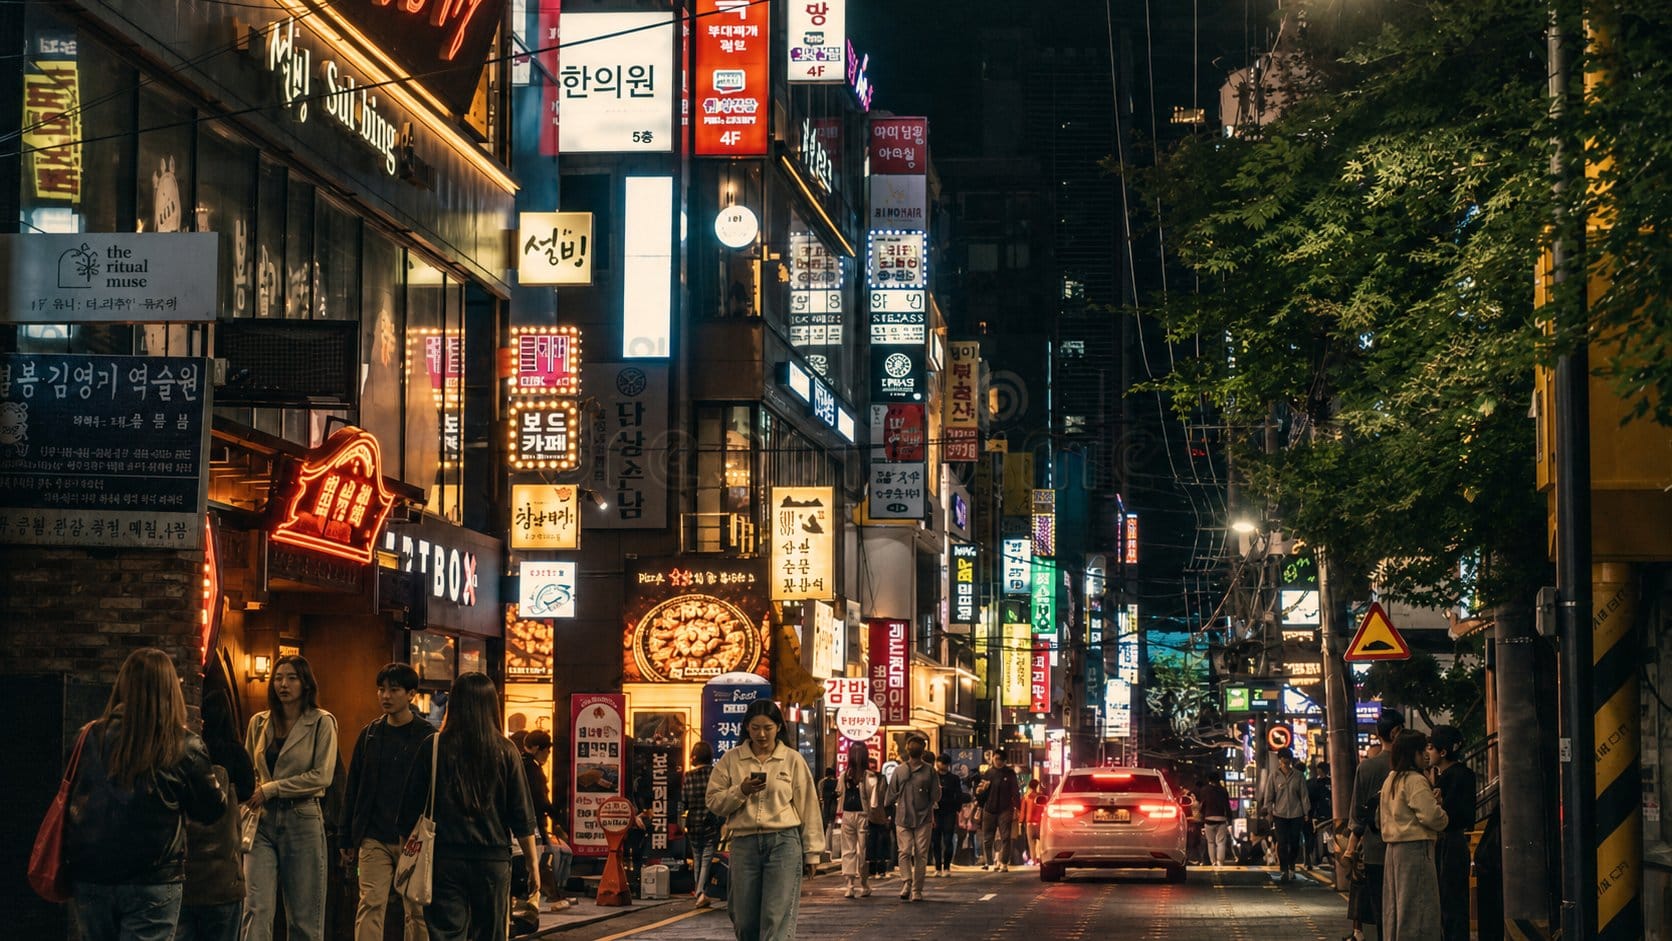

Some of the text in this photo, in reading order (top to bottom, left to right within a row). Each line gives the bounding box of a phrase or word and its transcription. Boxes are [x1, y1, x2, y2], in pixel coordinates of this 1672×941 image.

[807, 66, 825, 77] 4F
[560, 64, 655, 99] 한의원
[632, 130, 653, 144] 5층
[719, 131, 741, 146] 4F
[107, 245, 132, 259] the
[106, 259, 149, 273] ritual
[106, 277, 147, 288] muse
[521, 434, 567, 452] 카페
